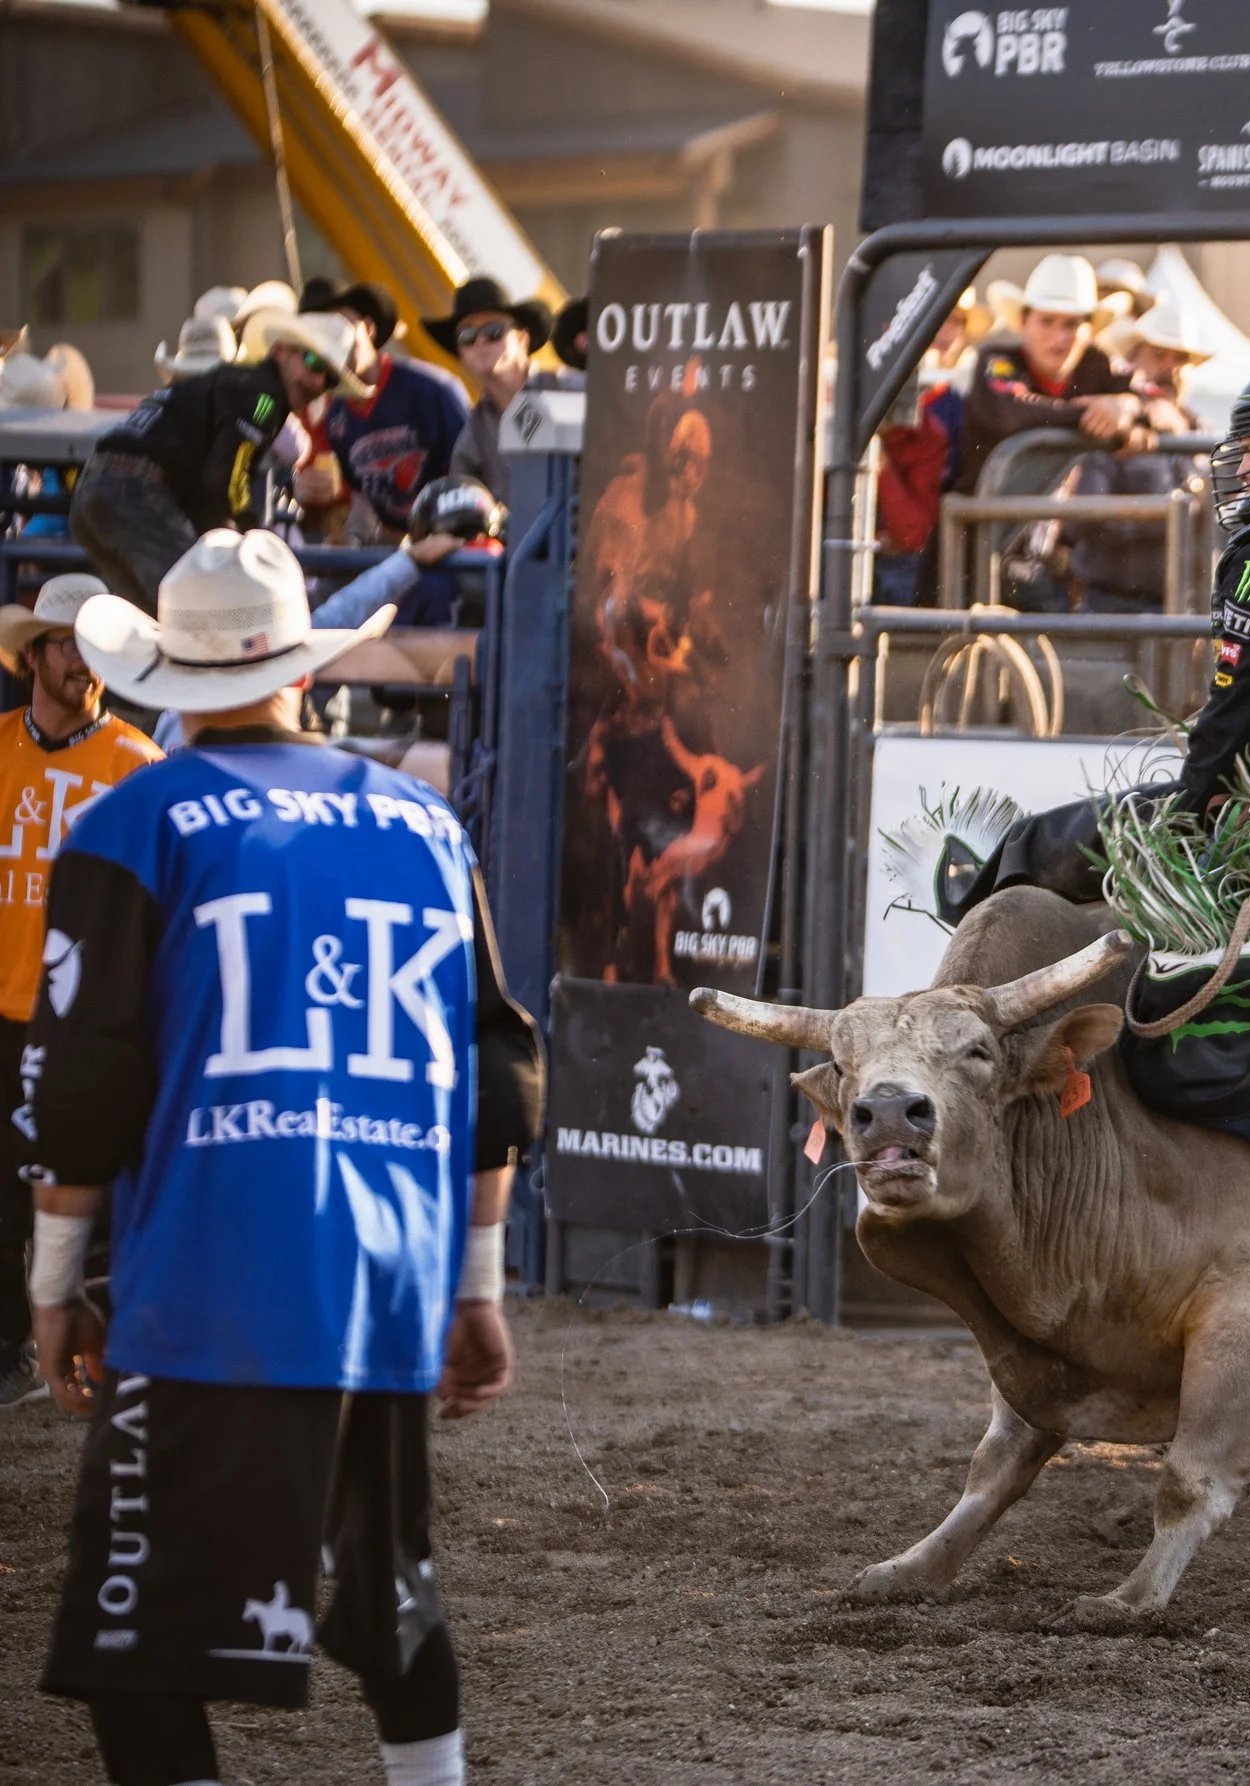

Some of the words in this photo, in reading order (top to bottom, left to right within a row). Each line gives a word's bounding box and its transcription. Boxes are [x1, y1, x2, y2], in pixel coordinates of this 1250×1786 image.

[996, 10, 1029, 32] BIG
[1032, 7, 1069, 31] SKY
[995, 31, 1068, 77] PBR
[352, 35, 470, 206] MIDWAY
[973, 141, 1109, 169] MOONLIGHT
[1110, 139, 1182, 164] BASIN
[597, 301, 791, 351] OUTLAW
[624, 364, 758, 393] EVENTS
[167, 788, 263, 838] BIG
[266, 788, 360, 827] SKY
[366, 793, 463, 846] PBR
[674, 931, 699, 956] BIG
[700, 932, 728, 958] SKY
[728, 934, 758, 960] PBR
[192, 892, 474, 1091] L&K
[557, 1126, 763, 1176] MARINES.COM
